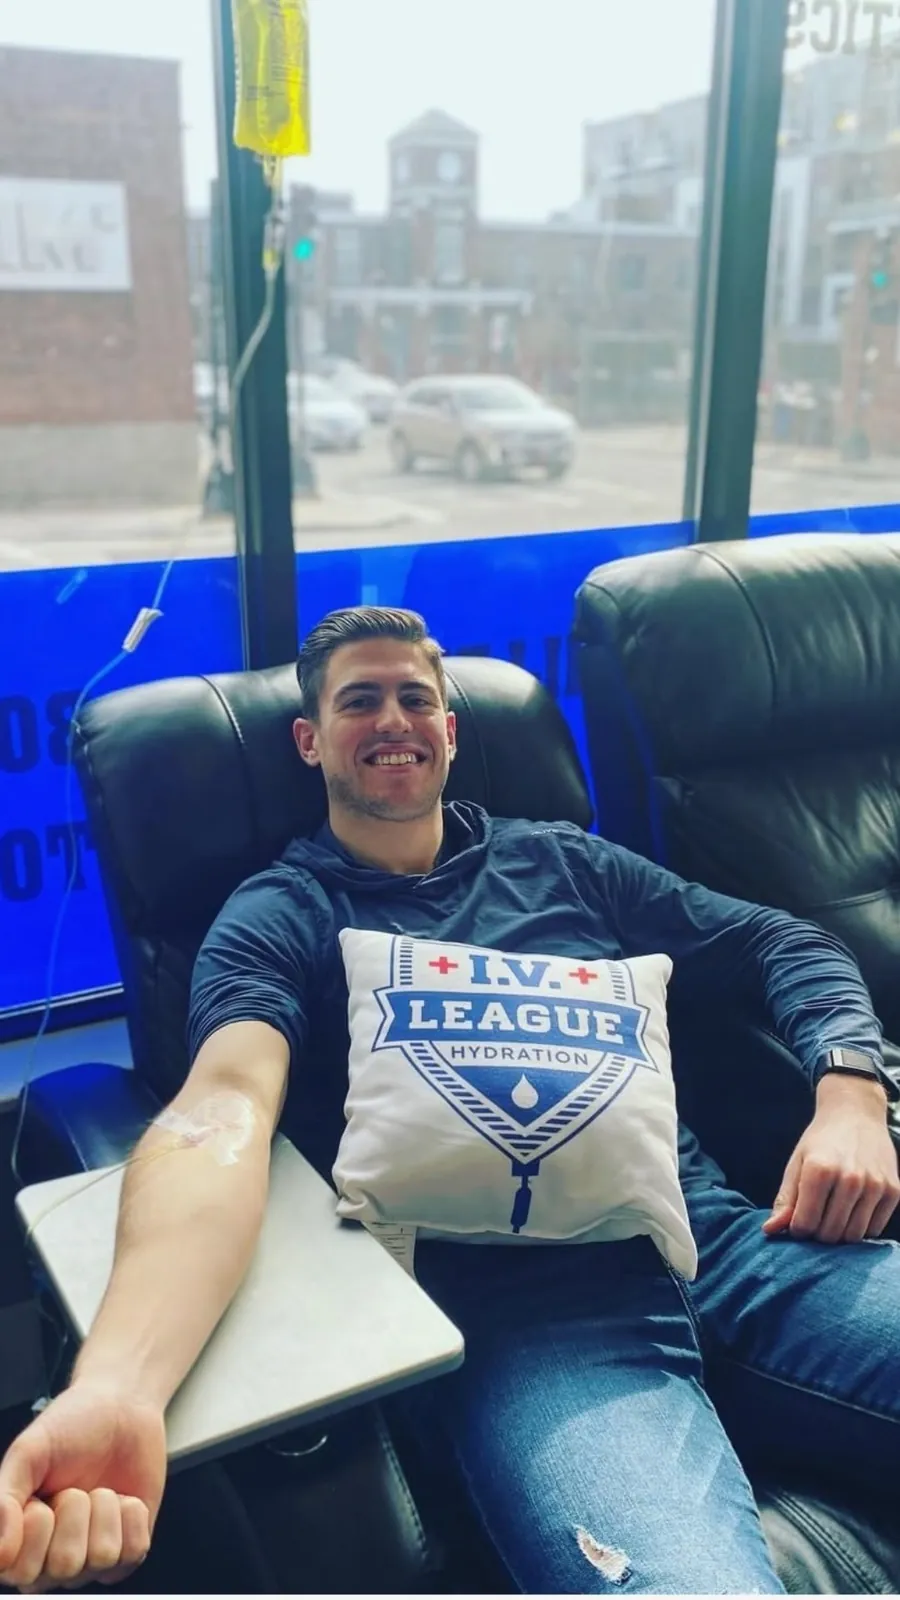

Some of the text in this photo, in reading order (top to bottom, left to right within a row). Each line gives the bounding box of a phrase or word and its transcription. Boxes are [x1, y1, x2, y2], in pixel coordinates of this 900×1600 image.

[470, 955, 561, 989] I.V.
[409, 1001, 624, 1044] LEAGUE
[452, 1046, 588, 1065] HYDRATION
